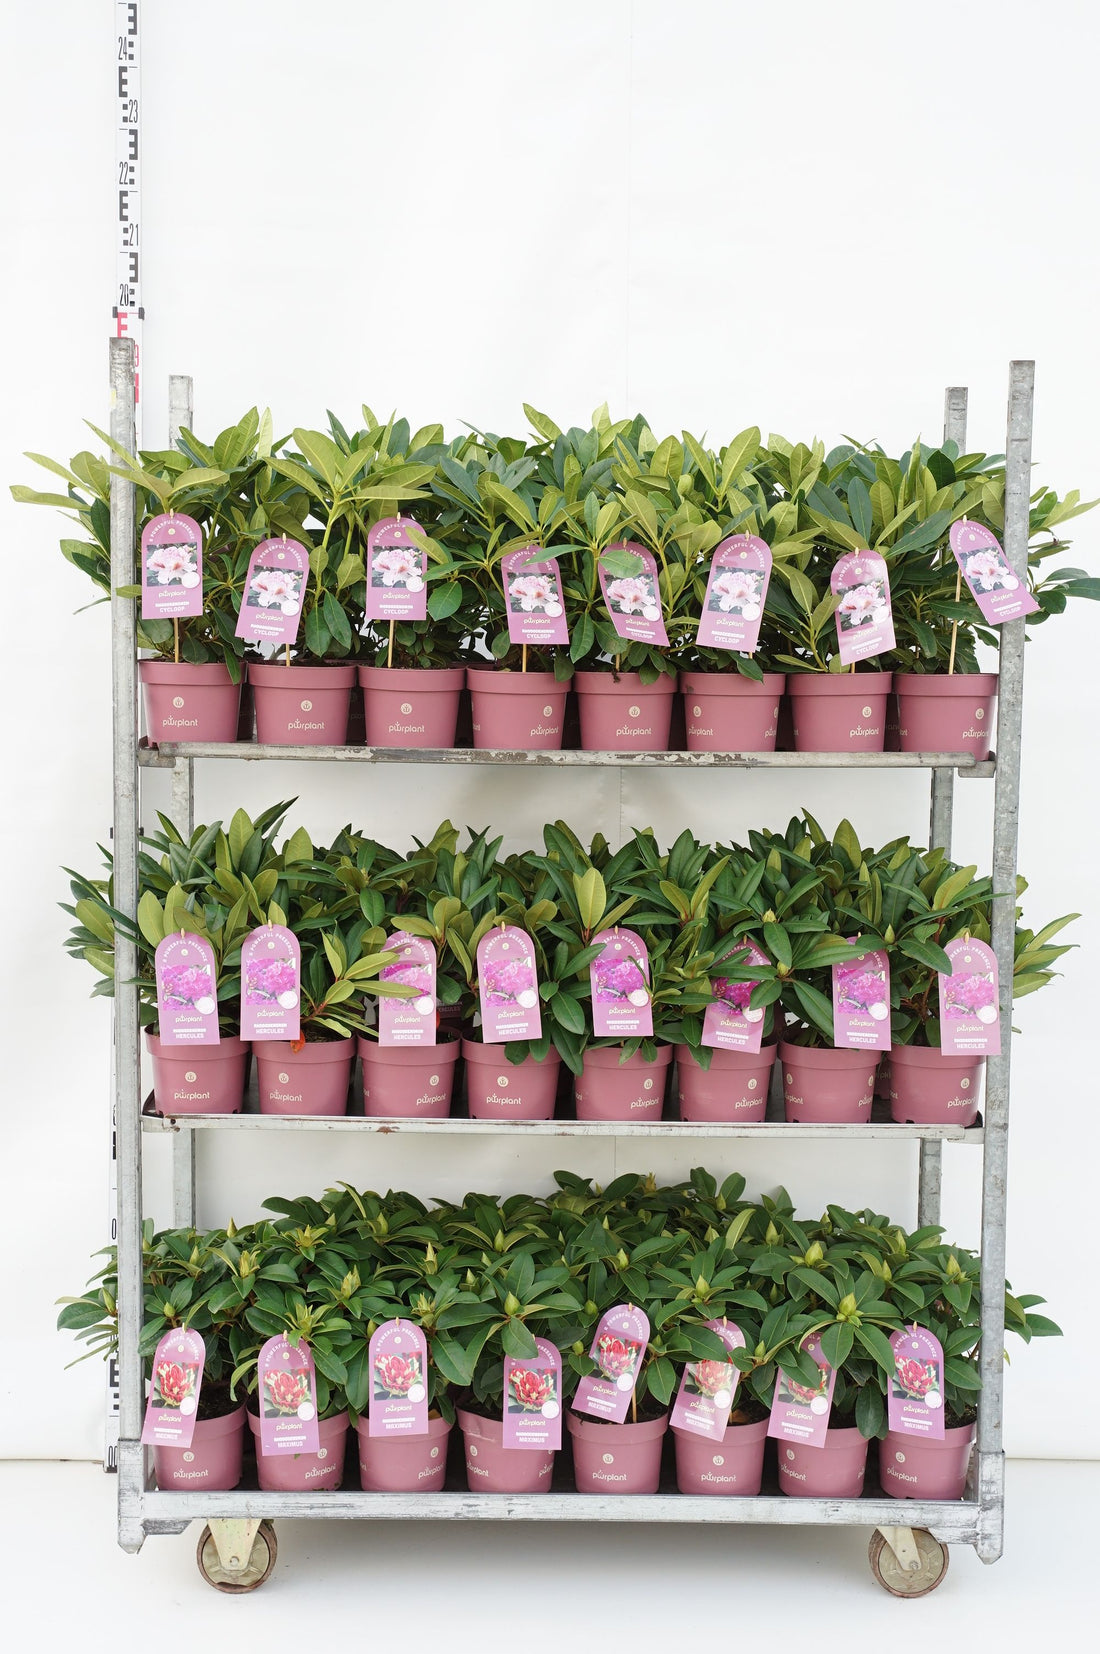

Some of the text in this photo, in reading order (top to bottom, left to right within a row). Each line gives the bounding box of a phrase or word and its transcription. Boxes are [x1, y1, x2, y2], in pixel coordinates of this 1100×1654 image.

[118, 36, 127, 60] 24
[129, 99, 138, 123] 23
[119, 161, 128, 184] 22
[129, 223, 138, 246] 21
[119, 284, 128, 306] 20
